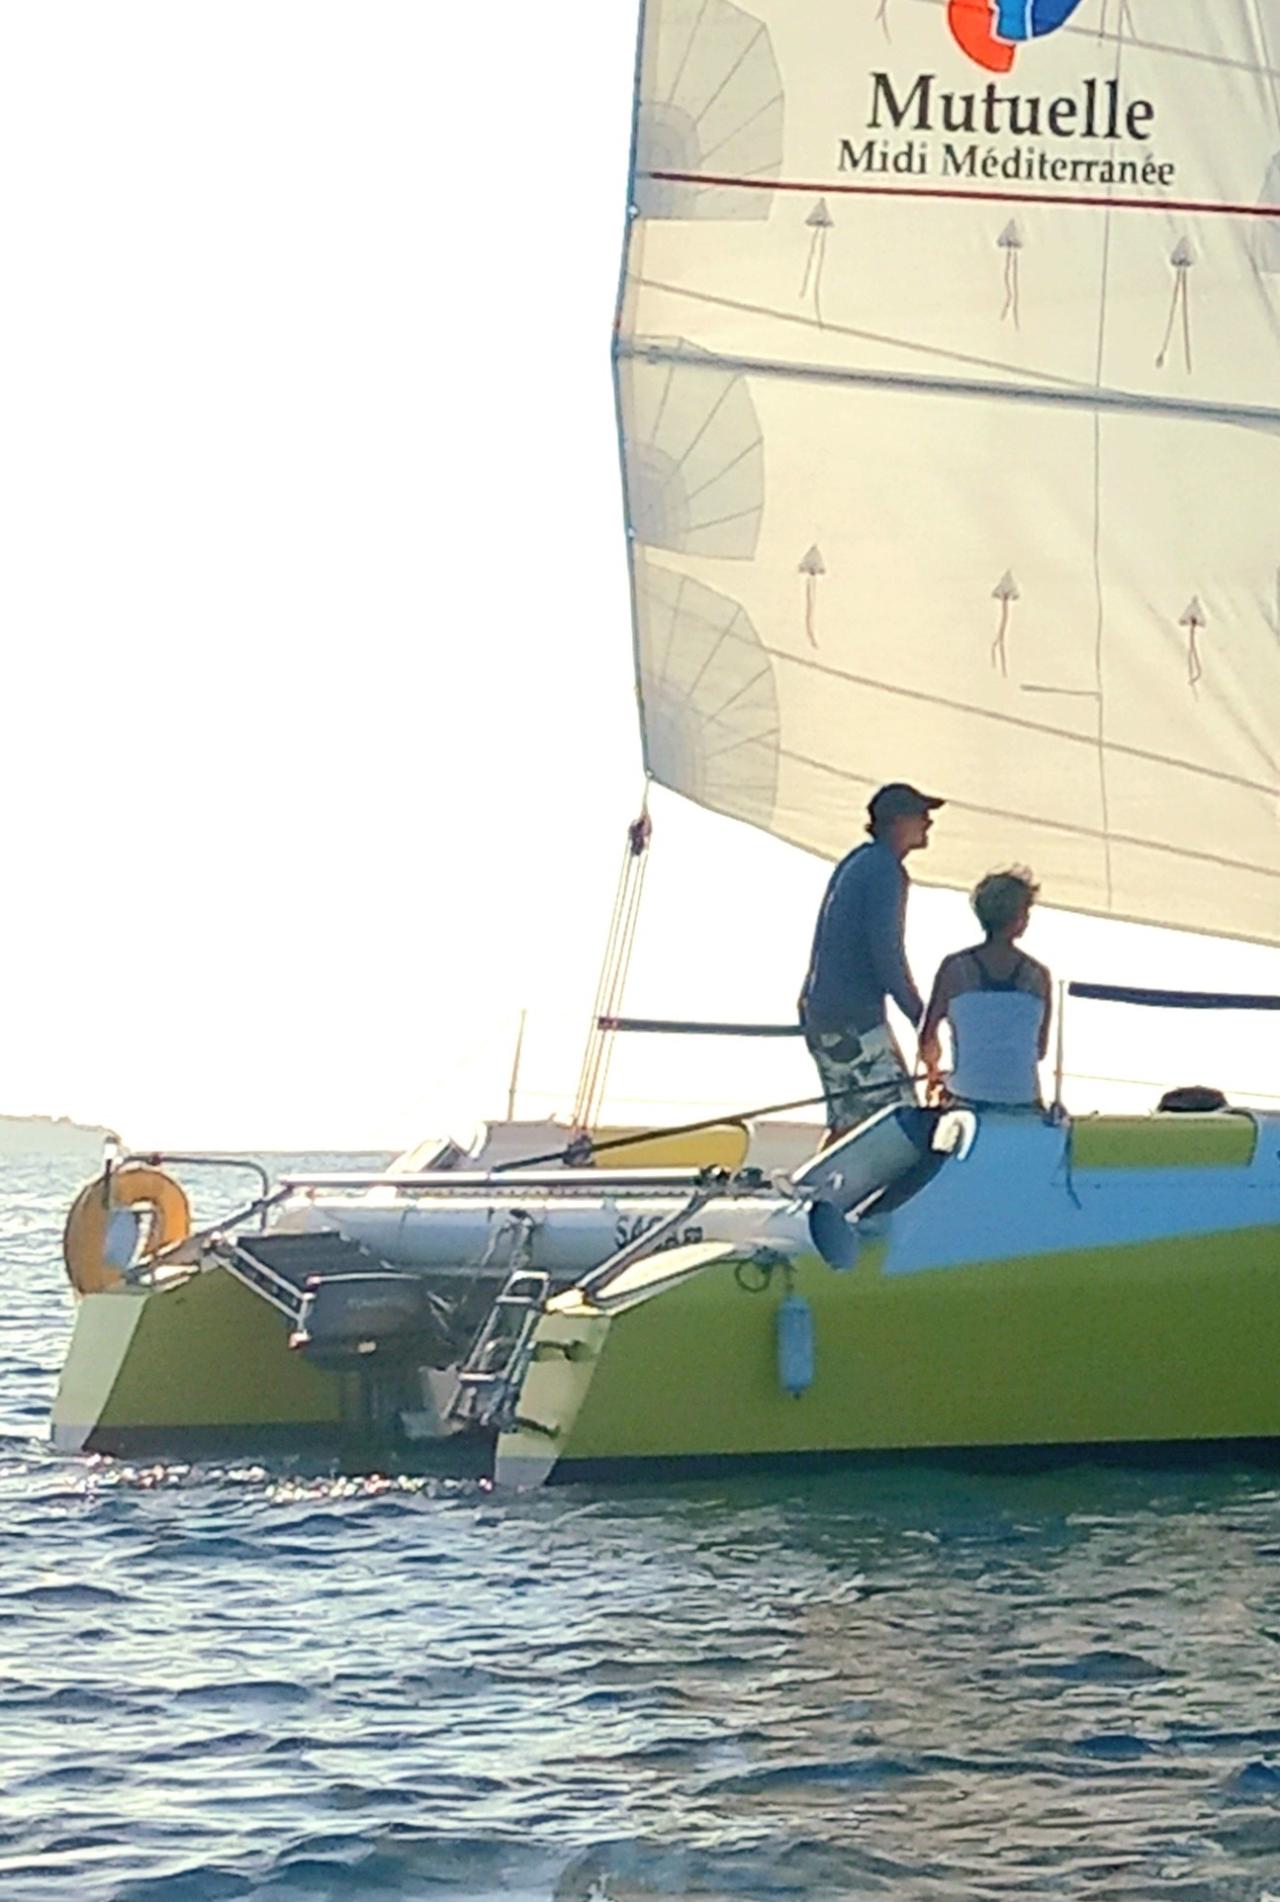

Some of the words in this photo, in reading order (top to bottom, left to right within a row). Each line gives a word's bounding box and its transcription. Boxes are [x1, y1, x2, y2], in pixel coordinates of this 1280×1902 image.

[865, 71, 1155, 141] Mutuelle
[837, 138, 929, 175] Midi
[941, 142, 1176, 186] Méditerranée
